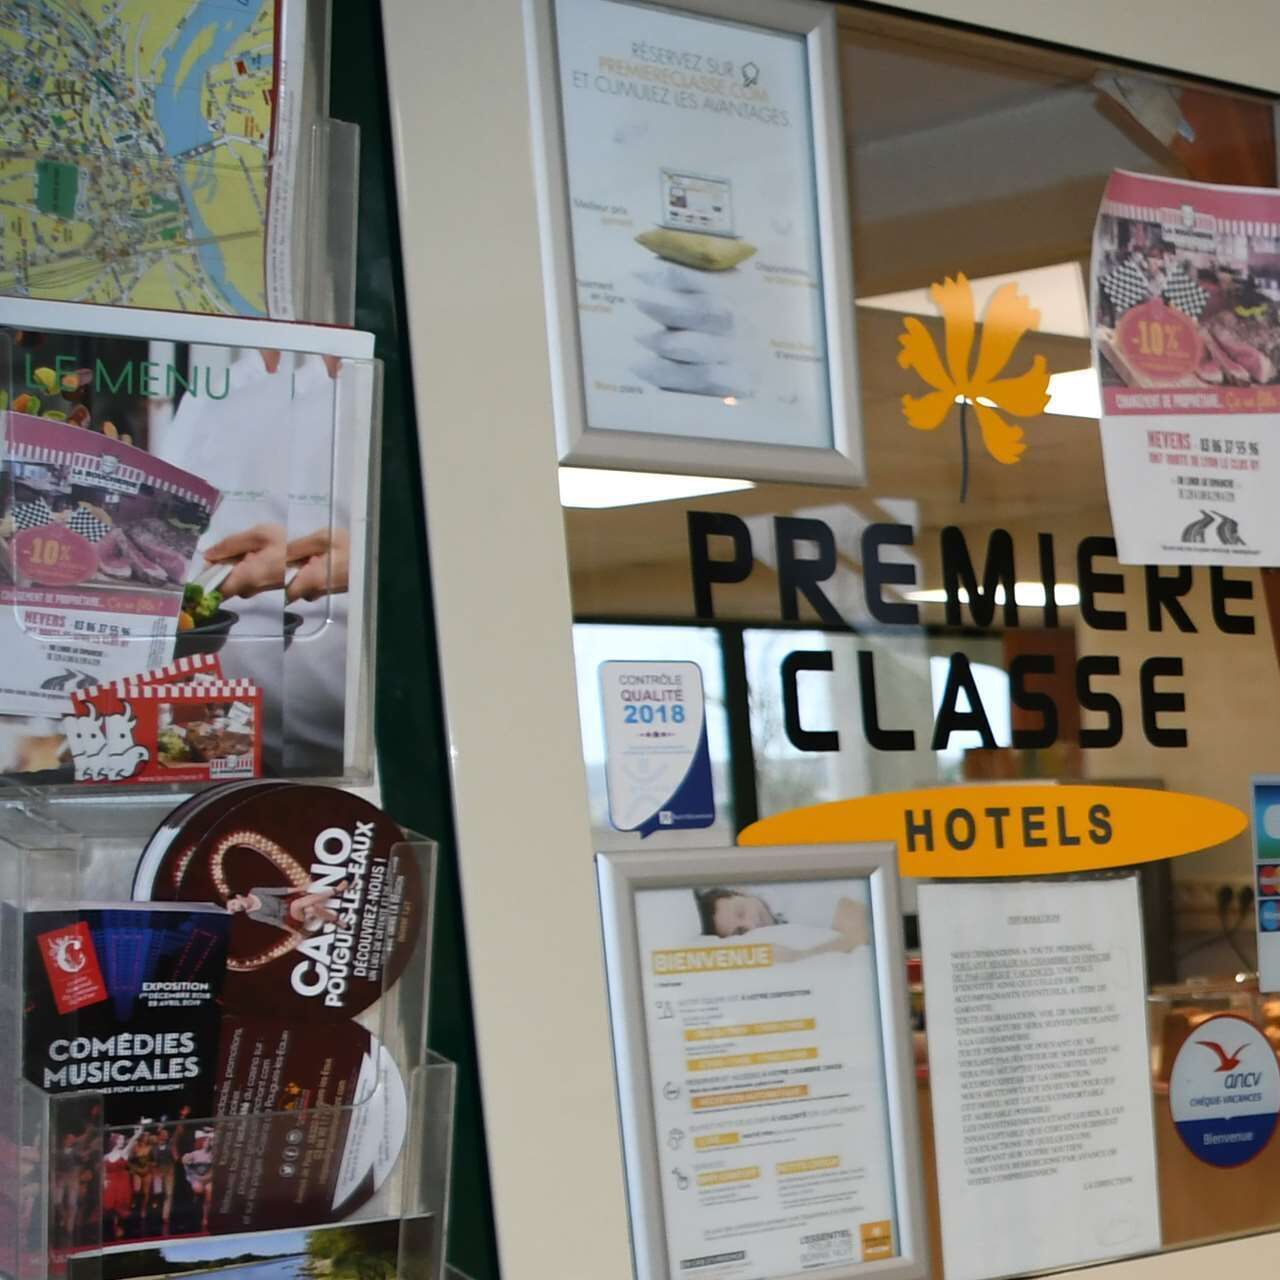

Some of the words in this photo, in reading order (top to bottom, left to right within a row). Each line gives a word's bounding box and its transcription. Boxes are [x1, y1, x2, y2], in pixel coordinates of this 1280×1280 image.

[707, 57, 735, 77] SUR
[572, 70, 589, 89] ET
[674, 90, 698, 110] LES
[25, 352, 78, 391] LE
[93, 358, 231, 400] MENU
[1147, 430, 1191, 449] NEVERS
[618, 672, 683, 686] CONTRÔLE
[780, 650, 1189, 753] CLASSE
[624, 704, 685, 724] 2018
[904, 804, 1114, 853] HOTELS
[655, 947, 771, 973] BIENVENUE
[142, 981, 209, 992] EXPOSITION
[49, 1031, 195, 1062] COMÉDIES
[43, 1056, 199, 1089] MUSICALES
[1224, 1071, 1263, 1089] ancv
[1203, 1132, 1254, 1145] Bienvenue
